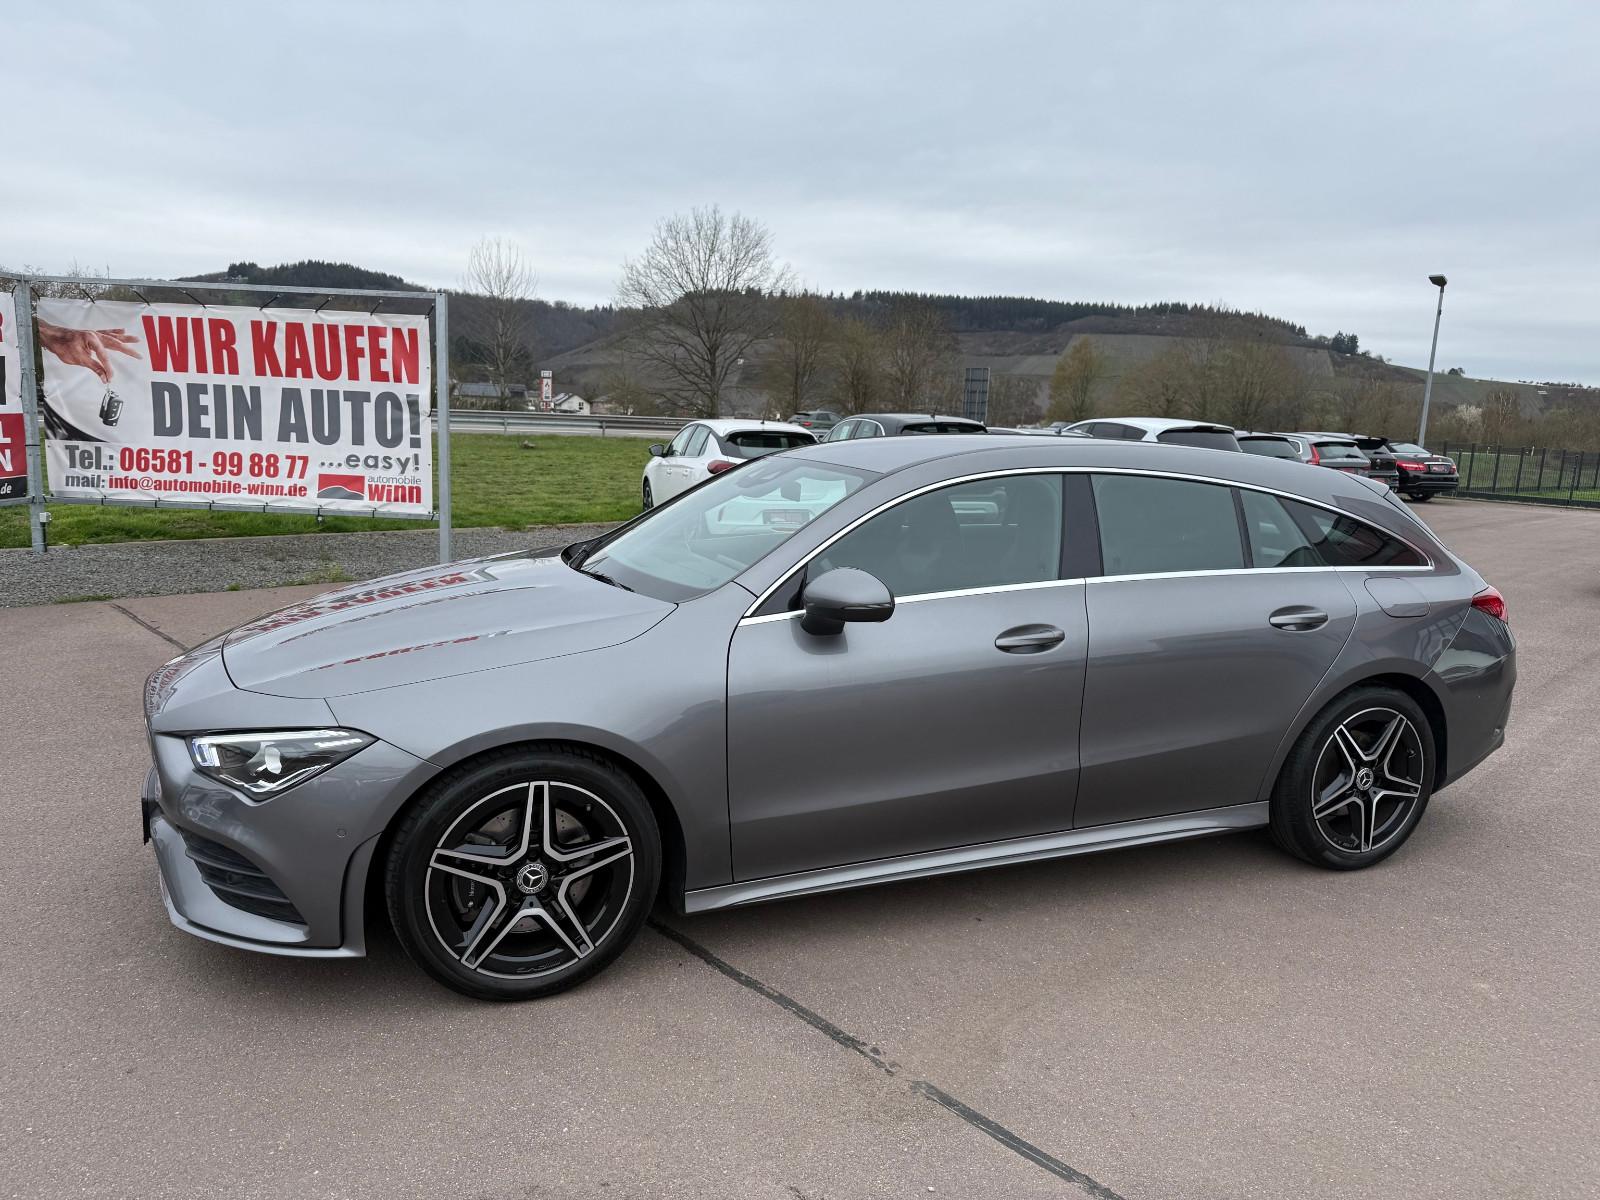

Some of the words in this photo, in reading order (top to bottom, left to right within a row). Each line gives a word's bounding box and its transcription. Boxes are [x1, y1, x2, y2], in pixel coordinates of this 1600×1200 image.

[142, 315, 240, 376] WIR
[250, 319, 419, 385] KAUFEN
[151, 381, 263, 442] DEIN
[277, 387, 422, 449] AUTO!
[65, 444, 114, 470] Tel.:
[120, 447, 192, 474] 06581
[212, 451, 243, 476] 99
[249, 452, 279, 479] 88
[285, 454, 309, 480] 77
[320, 453, 420, 474] ...easy!
[65, 474, 105, 488] mail:
[108, 474, 308, 497] info@automobile-winn.de
[367, 475, 422, 485] automobile
